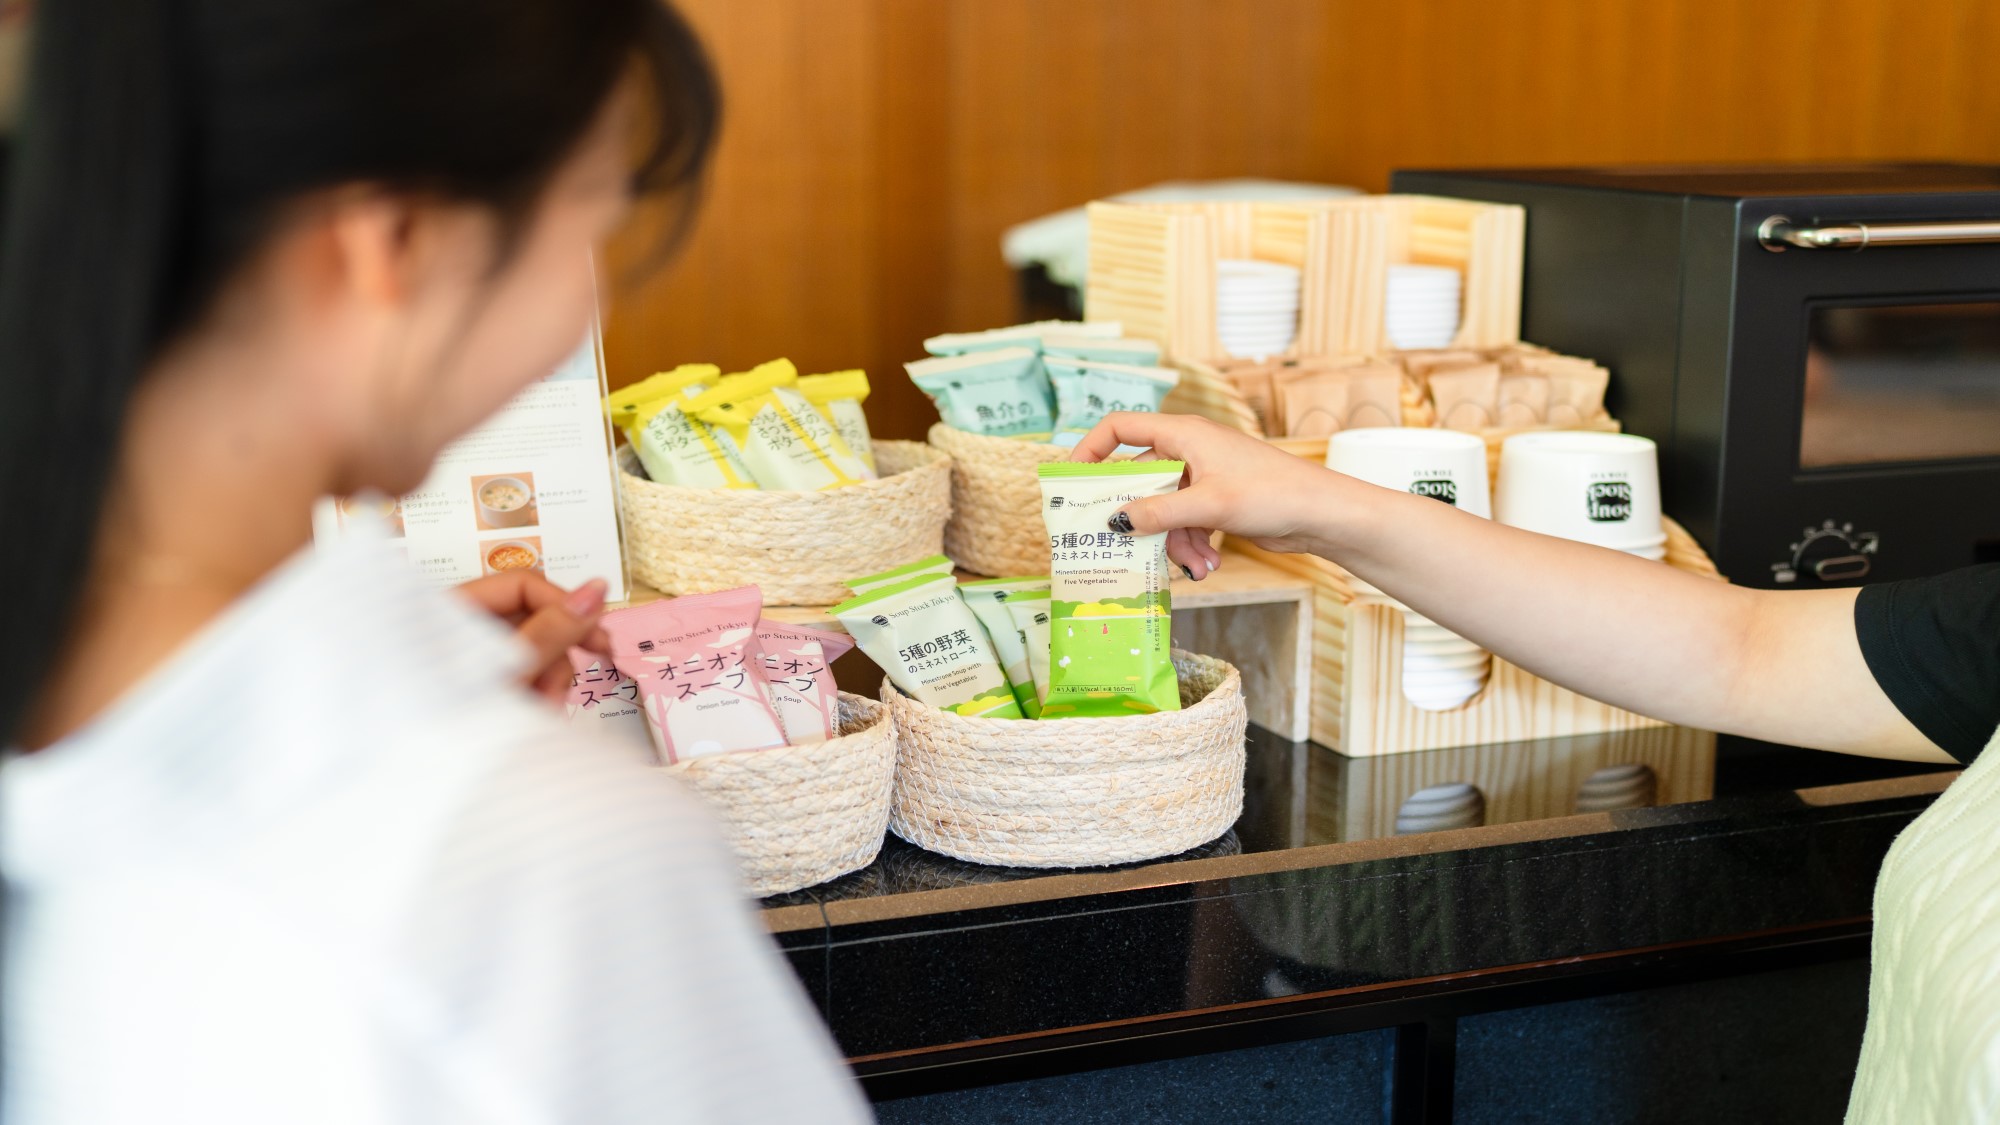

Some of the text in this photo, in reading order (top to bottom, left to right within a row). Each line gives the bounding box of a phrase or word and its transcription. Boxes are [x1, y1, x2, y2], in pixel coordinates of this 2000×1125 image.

[976, 402, 1034, 420] 魚介の
[1068, 500, 1090, 509] Soup
[1051, 532, 1135, 549] 5種の野菜
[1051, 549, 1134, 561] のミネストローネ
[1092, 568, 1111, 576] Soup
[1079, 578, 1118, 586] Vegetables
[889, 593, 955, 620] Soup Stock Tokyo
[658, 634, 684, 647] Soup
[685, 627, 714, 640] Stock
[717, 620, 748, 632] Tokyo
[773, 633, 800, 641] Stock
[899, 629, 973, 663] 5種の野菜
[657, 652, 746, 681] オニオン
[765, 658, 824, 676] ニオン
[908, 645, 979, 674] のミネストローネ
[921, 662, 982, 686] Minestrone Soup with
[934, 674, 978, 692] Five Vegetables
[676, 667, 747, 700] スープ
[770, 676, 817, 692] ープ
[581, 680, 639, 706] スープ
[783, 695, 802, 704] Soup
[600, 708, 638, 719] Onion Soup
[696, 698, 740, 711] Onion Soup
